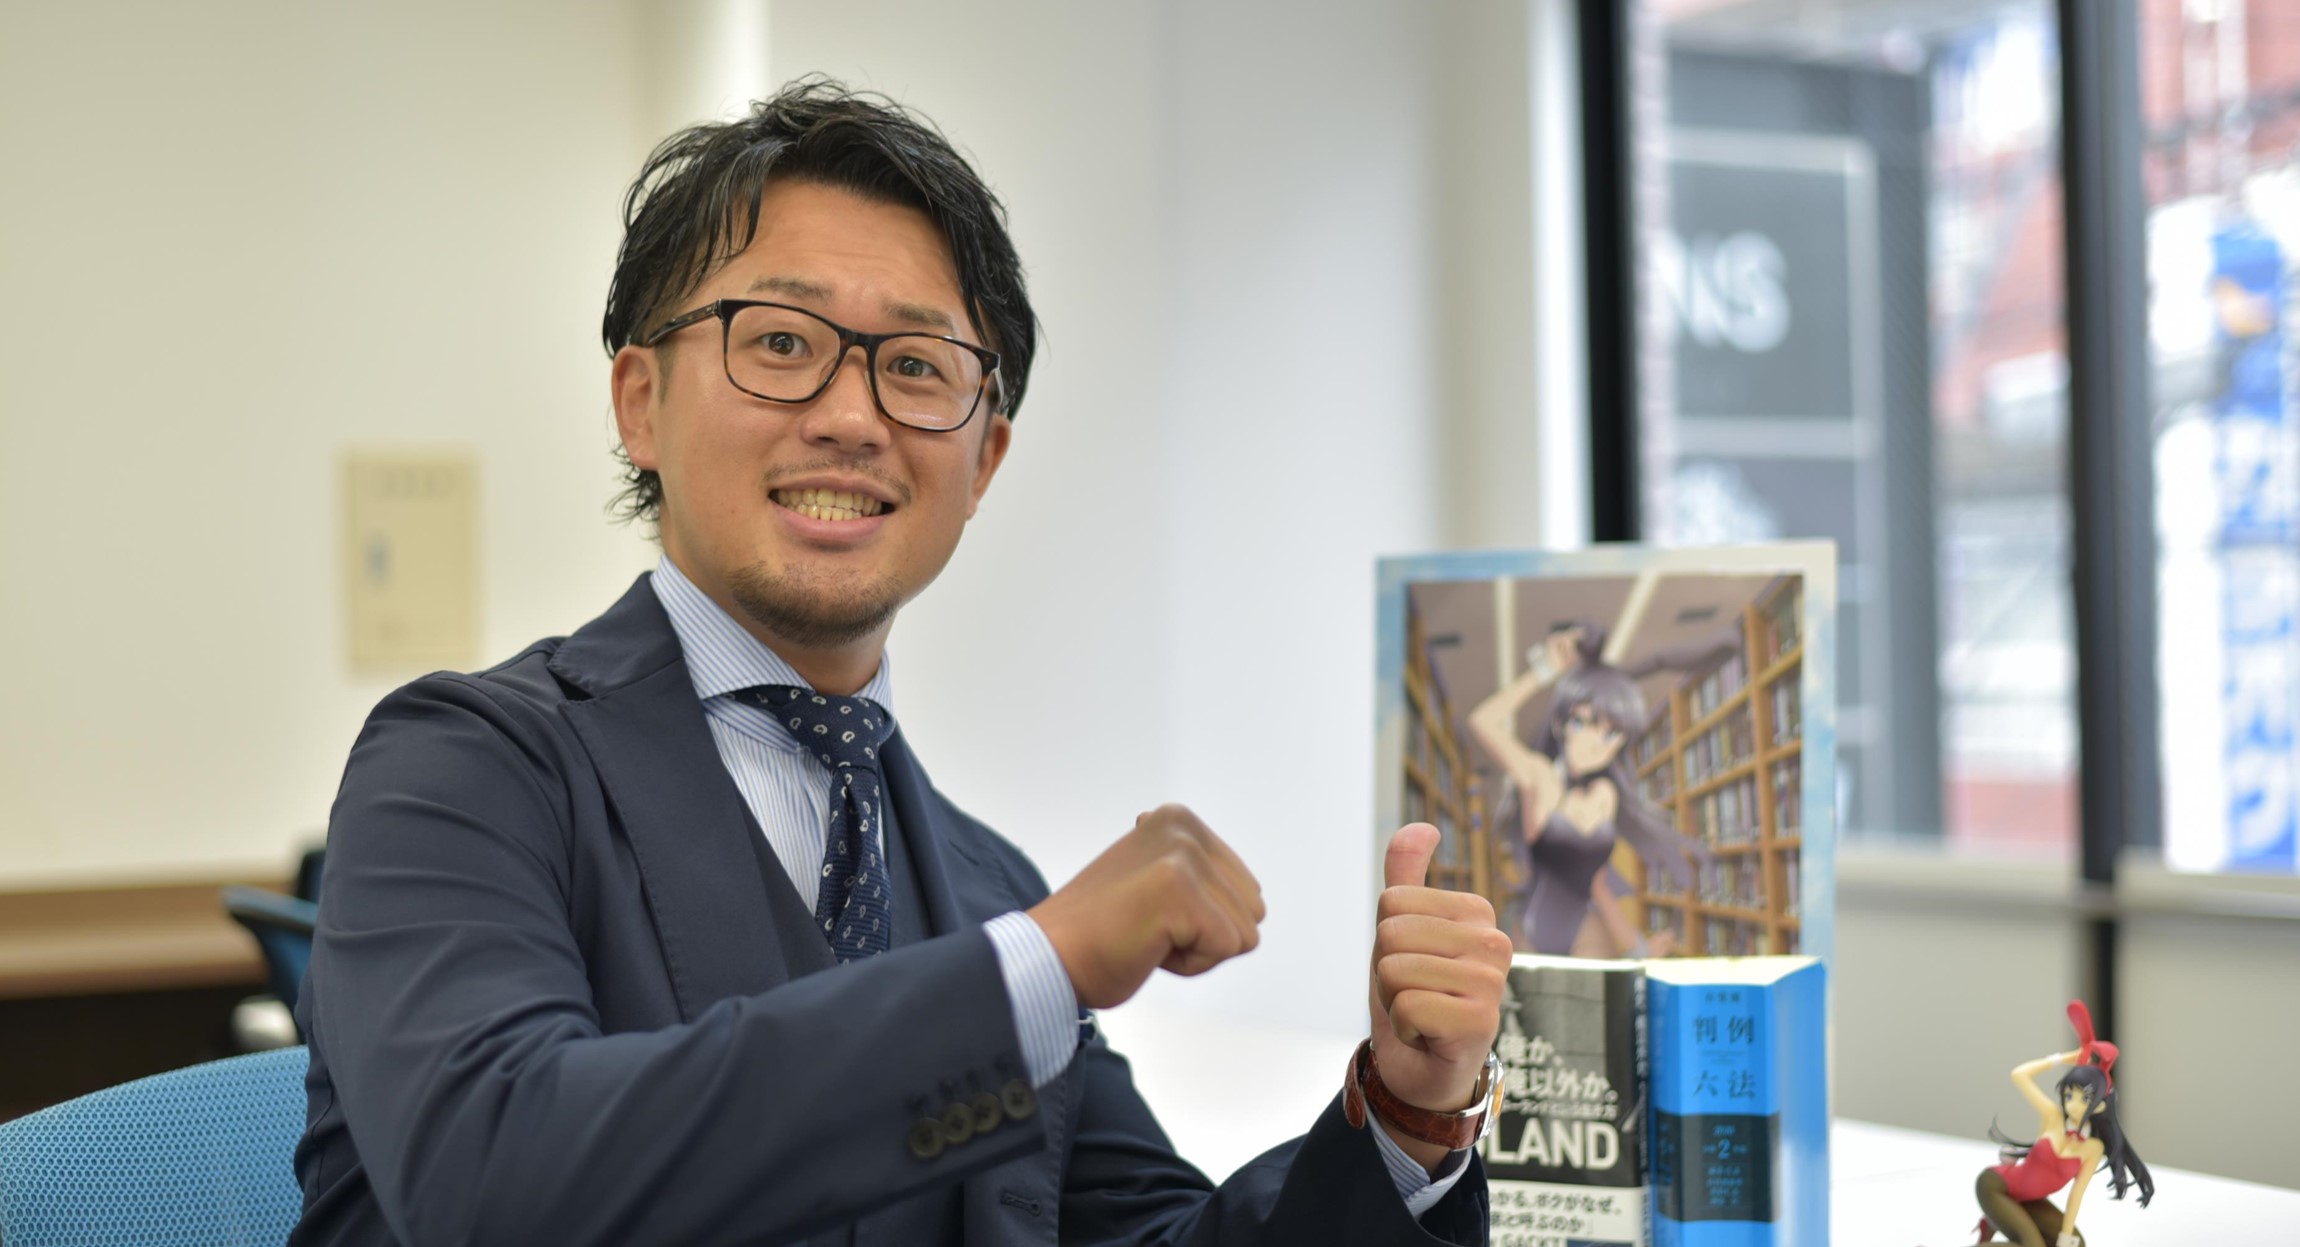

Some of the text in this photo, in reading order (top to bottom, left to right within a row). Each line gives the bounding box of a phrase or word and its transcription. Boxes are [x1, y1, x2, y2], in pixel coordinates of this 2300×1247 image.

[1692, 1016, 1755, 1045] 判例
[1692, 1070, 1756, 1099] 六法
[1476, 1117, 1620, 1170] LAND
